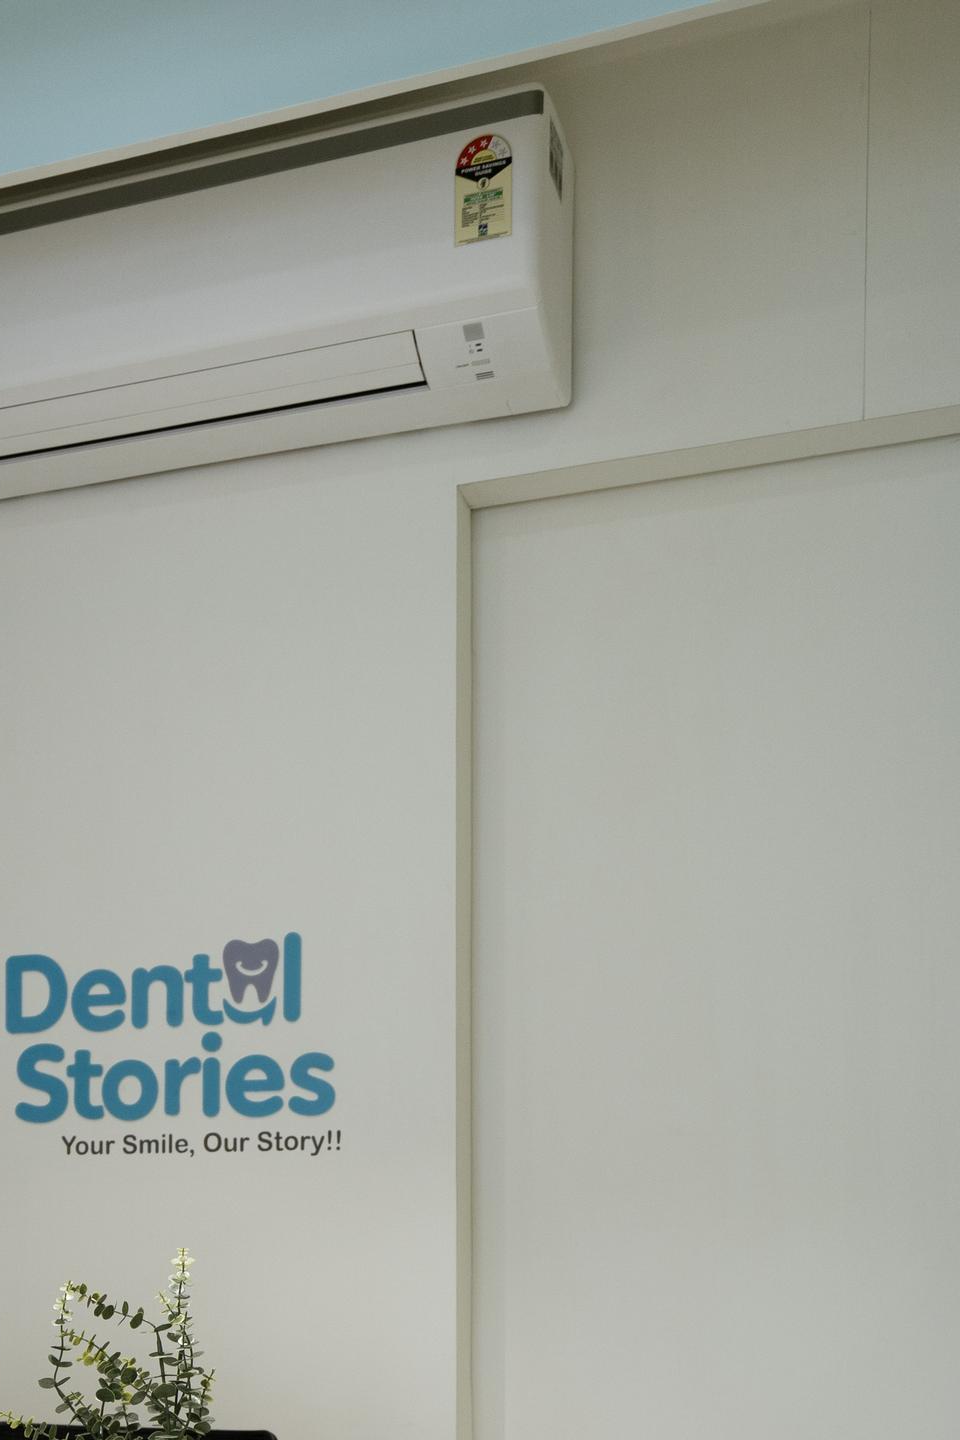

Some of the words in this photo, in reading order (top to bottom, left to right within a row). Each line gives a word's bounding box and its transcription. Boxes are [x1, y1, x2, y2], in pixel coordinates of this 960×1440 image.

[14, 1031, 337, 1124] Stories
[61, 1135, 116, 1156] Your
[122, 1133, 195, 1158] Smile,
[203, 1131, 250, 1153] Our
[257, 1129, 342, 1157] Story!!
